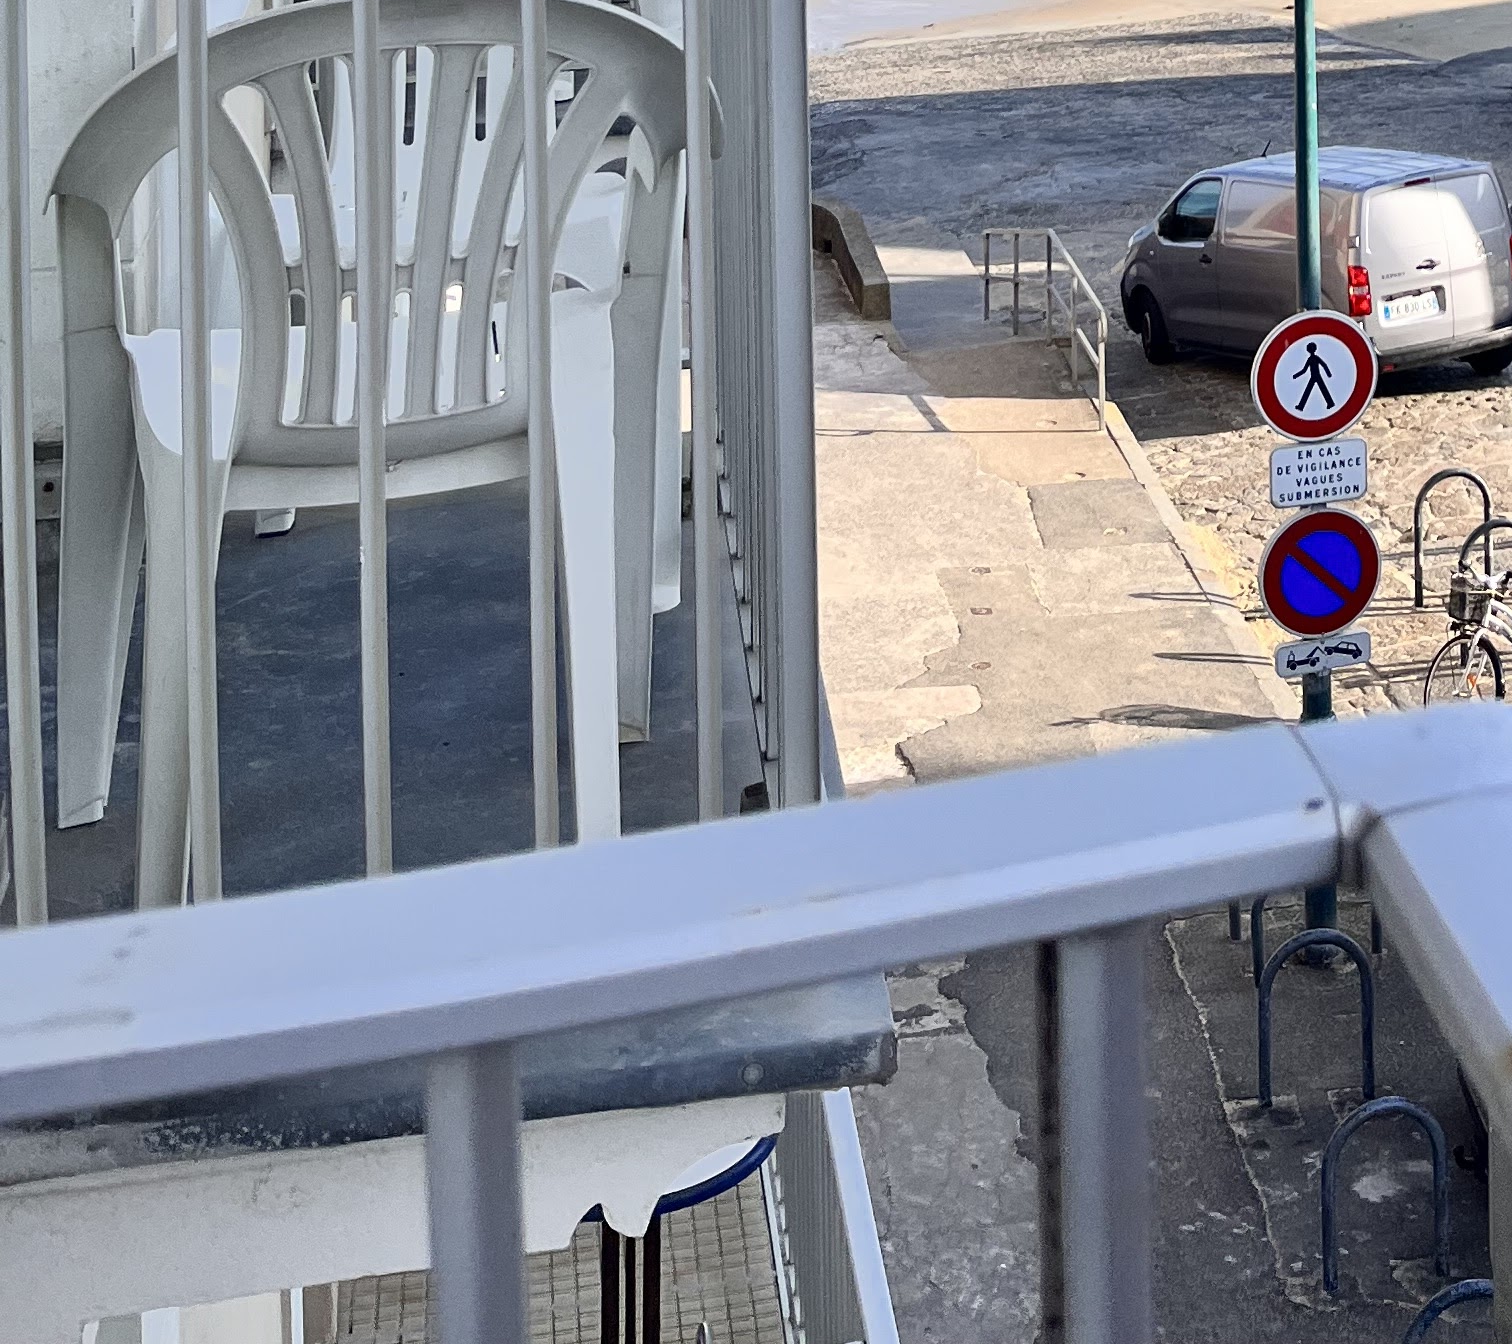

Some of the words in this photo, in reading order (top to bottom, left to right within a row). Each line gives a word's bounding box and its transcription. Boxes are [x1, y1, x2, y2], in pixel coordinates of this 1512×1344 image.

[1297, 450, 1312, 459] EN
[1319, 446, 1341, 457] CAS
[1277, 465, 1291, 476] DE
[1297, 457, 1361, 473] VIGILANCE
[1296, 473, 1343, 487] VAGUES
[1279, 484, 1360, 503] SUBMERSION
